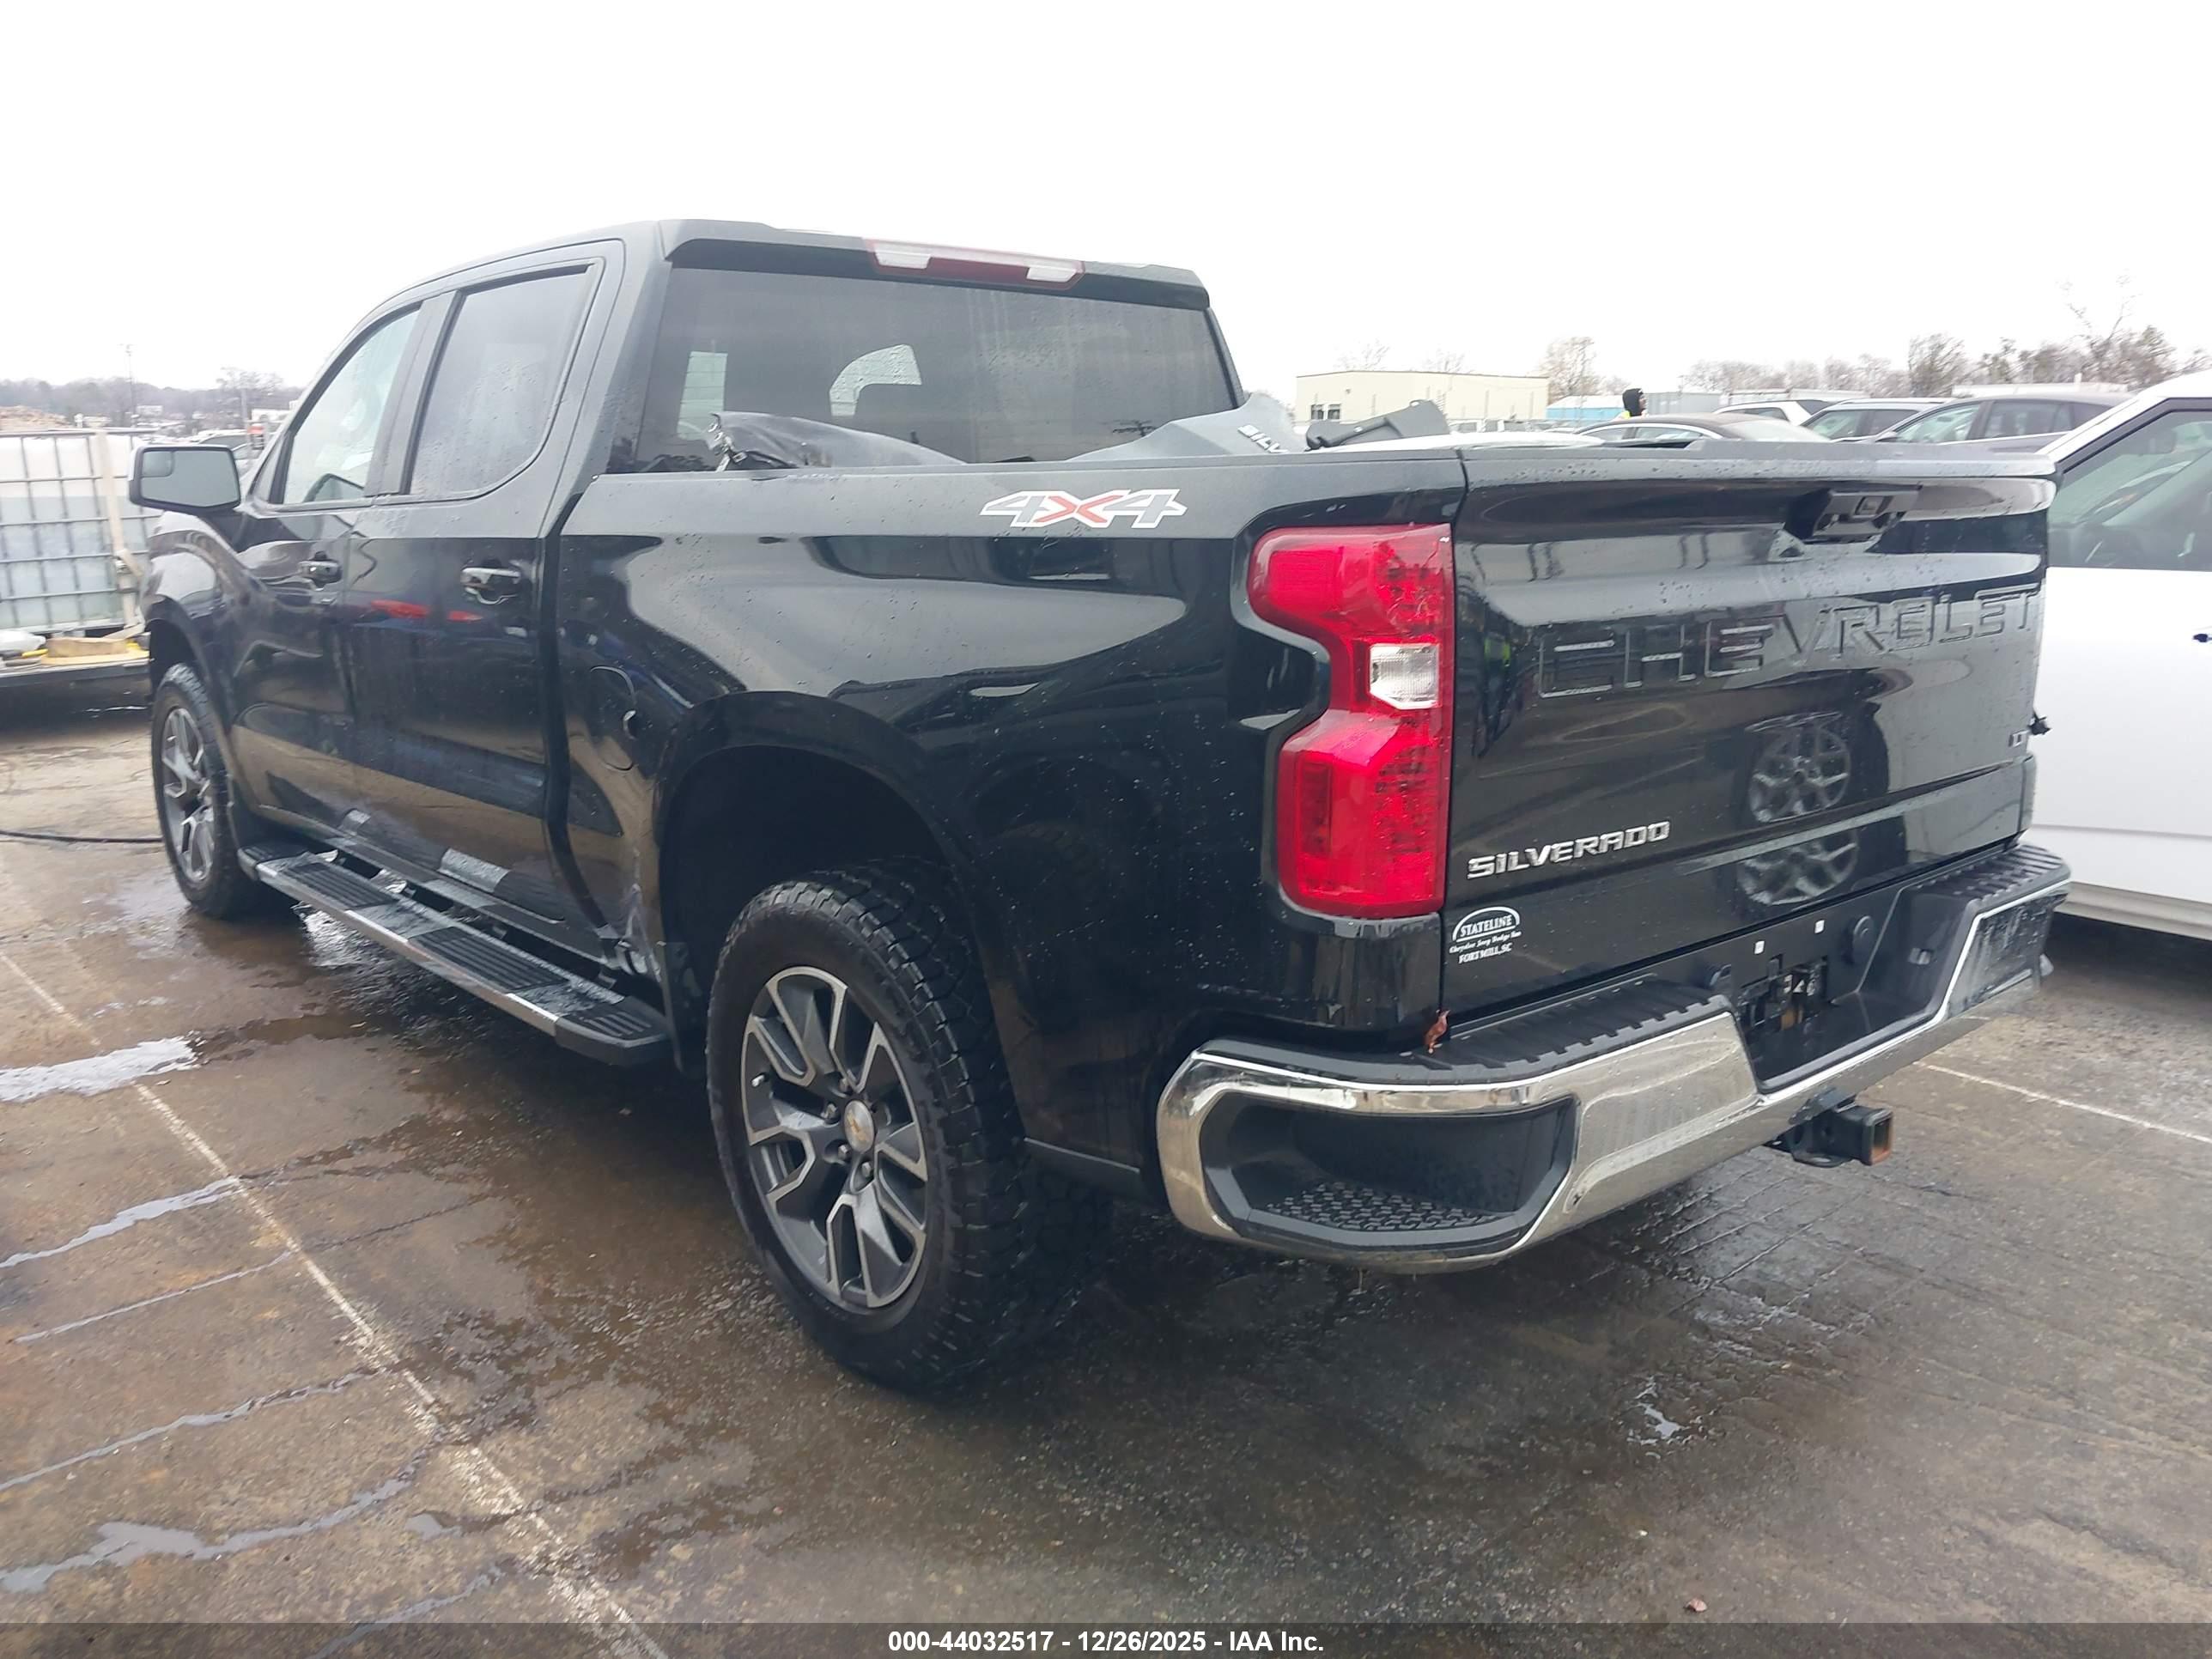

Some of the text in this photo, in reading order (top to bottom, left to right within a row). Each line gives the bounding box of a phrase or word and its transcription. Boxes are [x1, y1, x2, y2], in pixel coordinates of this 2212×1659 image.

[1537, 582, 2040, 698] CHEVROLET
[1467, 820, 1670, 879] SILVERADO
[1460, 914, 1513, 937] STATELINE
